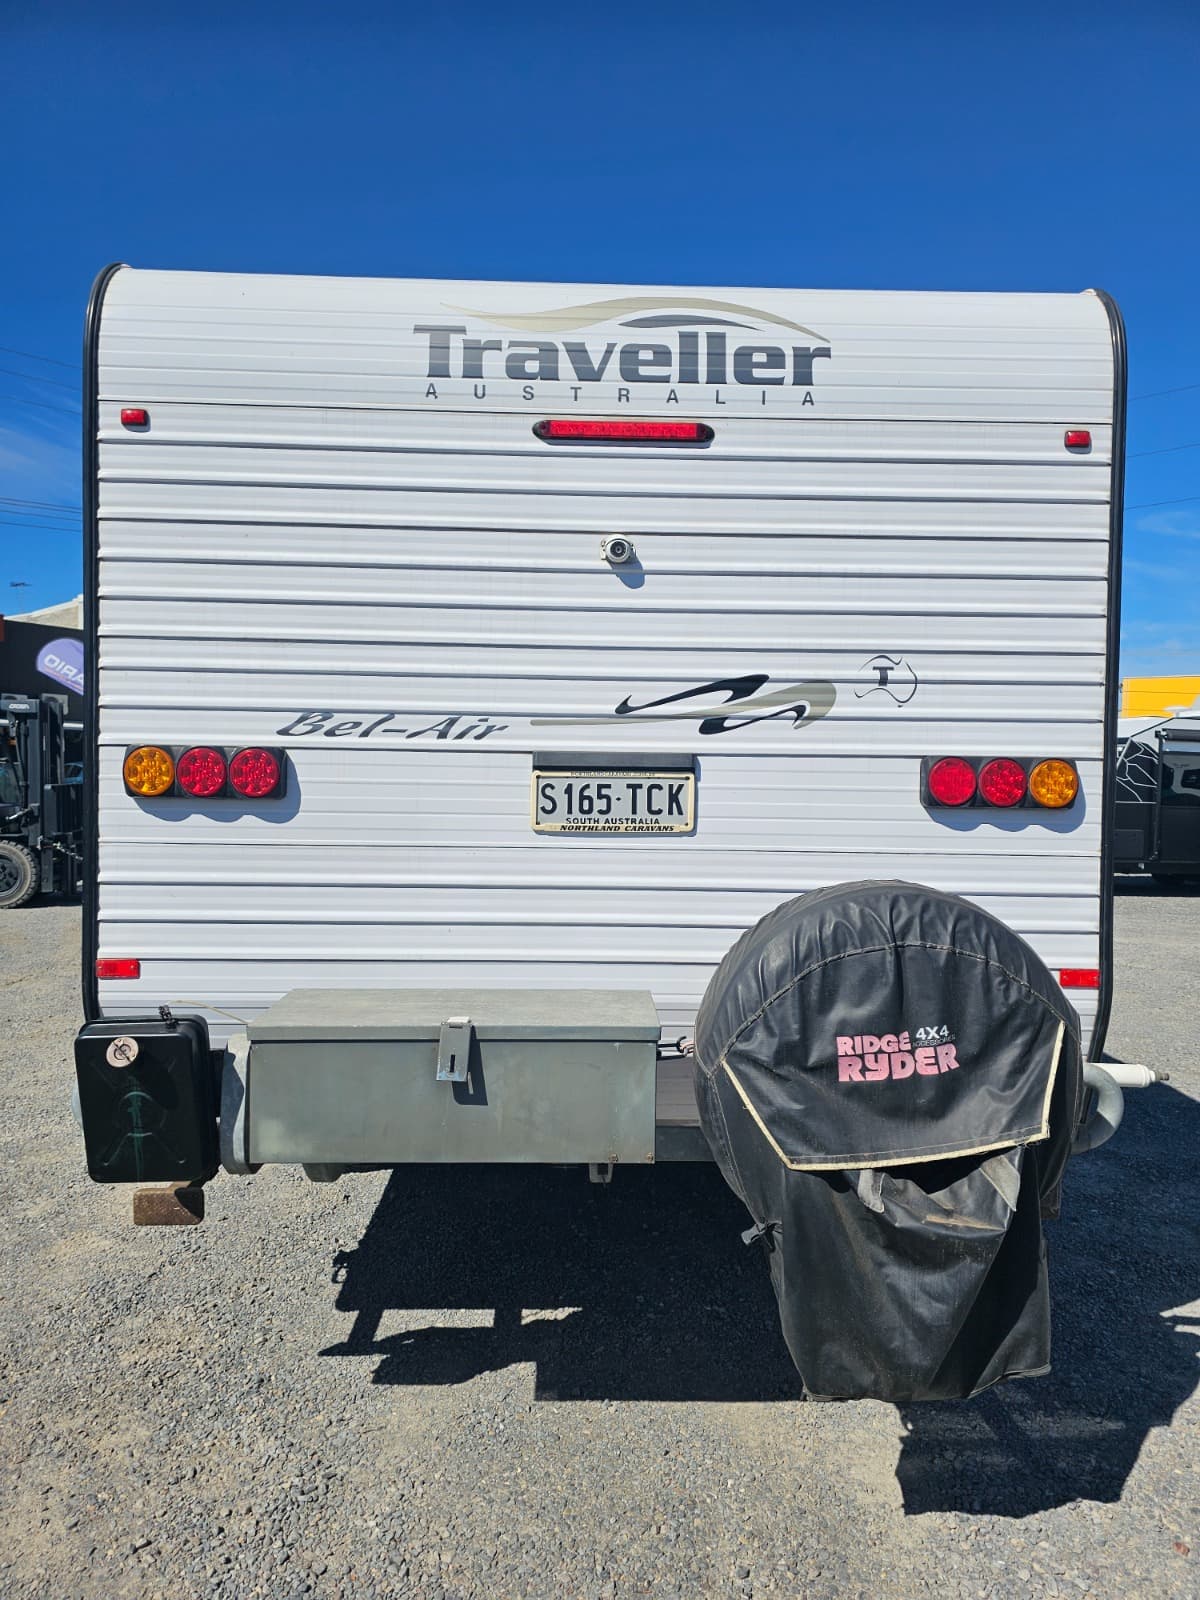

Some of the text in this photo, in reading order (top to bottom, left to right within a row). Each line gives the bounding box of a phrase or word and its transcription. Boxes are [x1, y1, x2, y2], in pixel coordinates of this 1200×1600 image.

[413, 325, 831, 386] Traveller
[425, 382, 814, 407] AUSTRALIA
[276, 711, 509, 740] Bel-Air
[566, 817, 600, 825] SOUTH
[836, 1031, 912, 1056] RIDGE
[838, 1043, 960, 1082] RYDER
